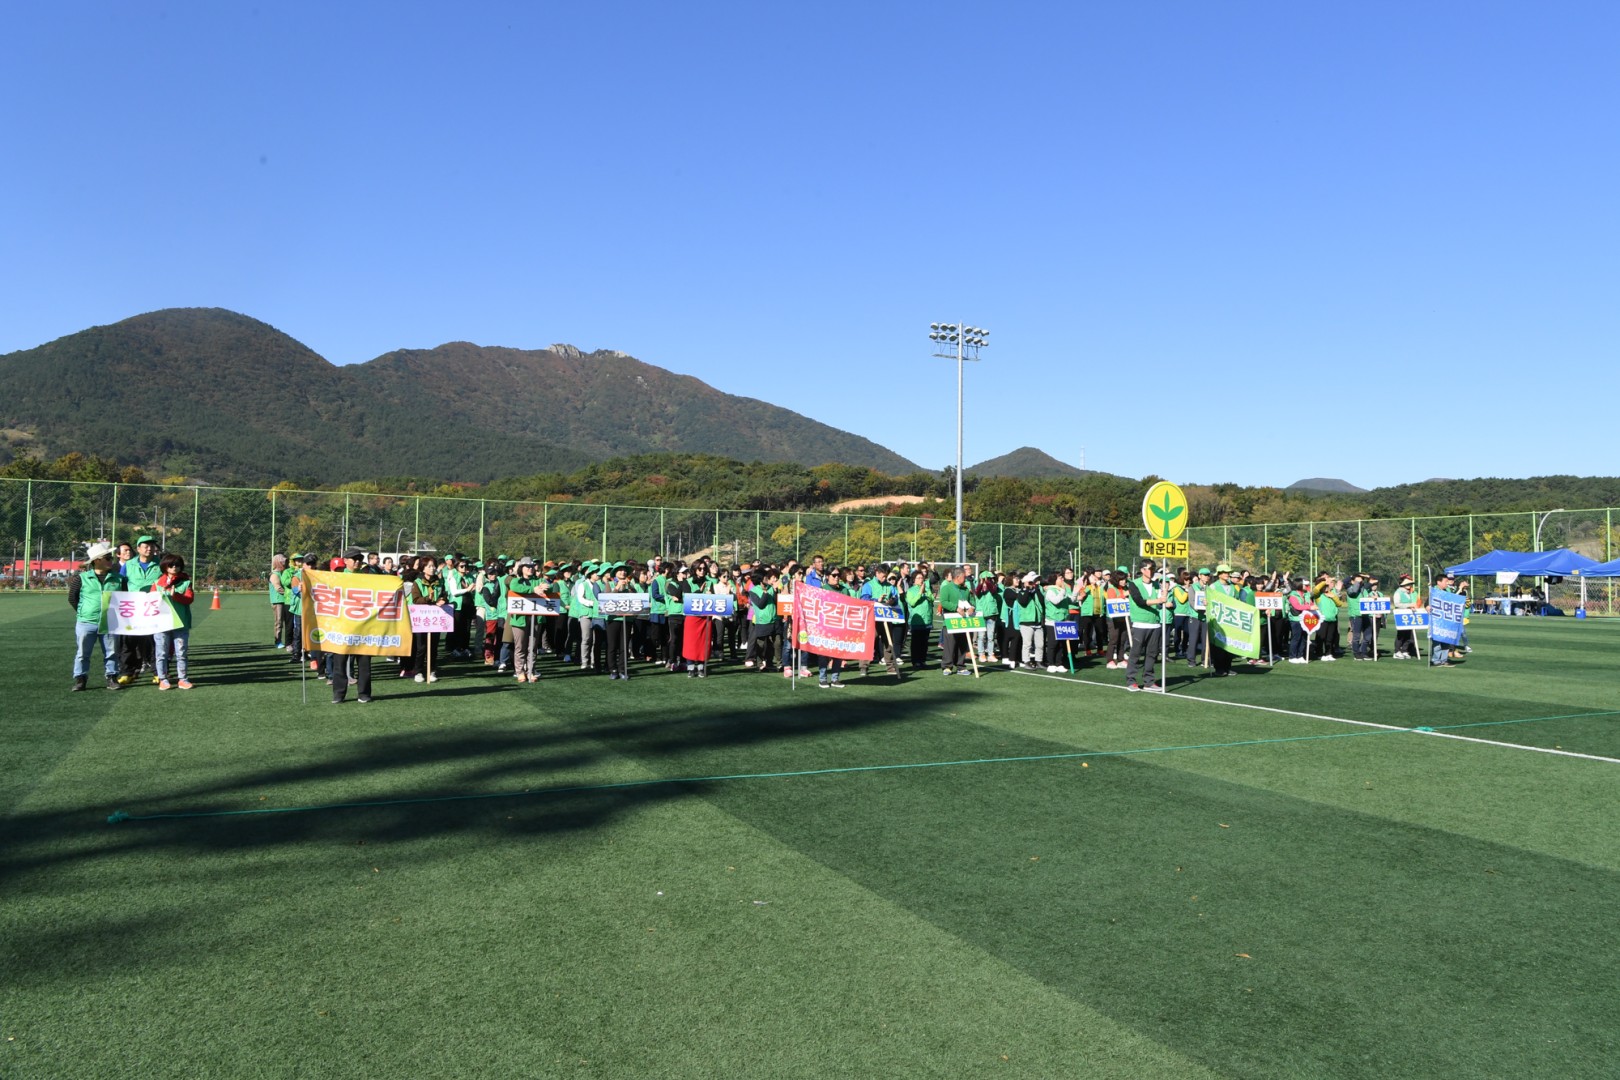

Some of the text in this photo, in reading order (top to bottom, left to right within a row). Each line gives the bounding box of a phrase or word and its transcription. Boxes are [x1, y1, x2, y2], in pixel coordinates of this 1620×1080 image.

[1144, 541, 1187, 556] 해운대구
[311, 583, 404, 620] 협동팀
[604, 599, 643, 612] 송정동
[691, 598, 727, 612] 좌2동
[800, 595, 869, 632] 단결팀
[1210, 600, 1254, 634] 자조팀
[1401, 614, 1424, 626] 우2동
[412, 616, 447, 627] 반송2동
[950, 617, 981, 629] 반송1동
